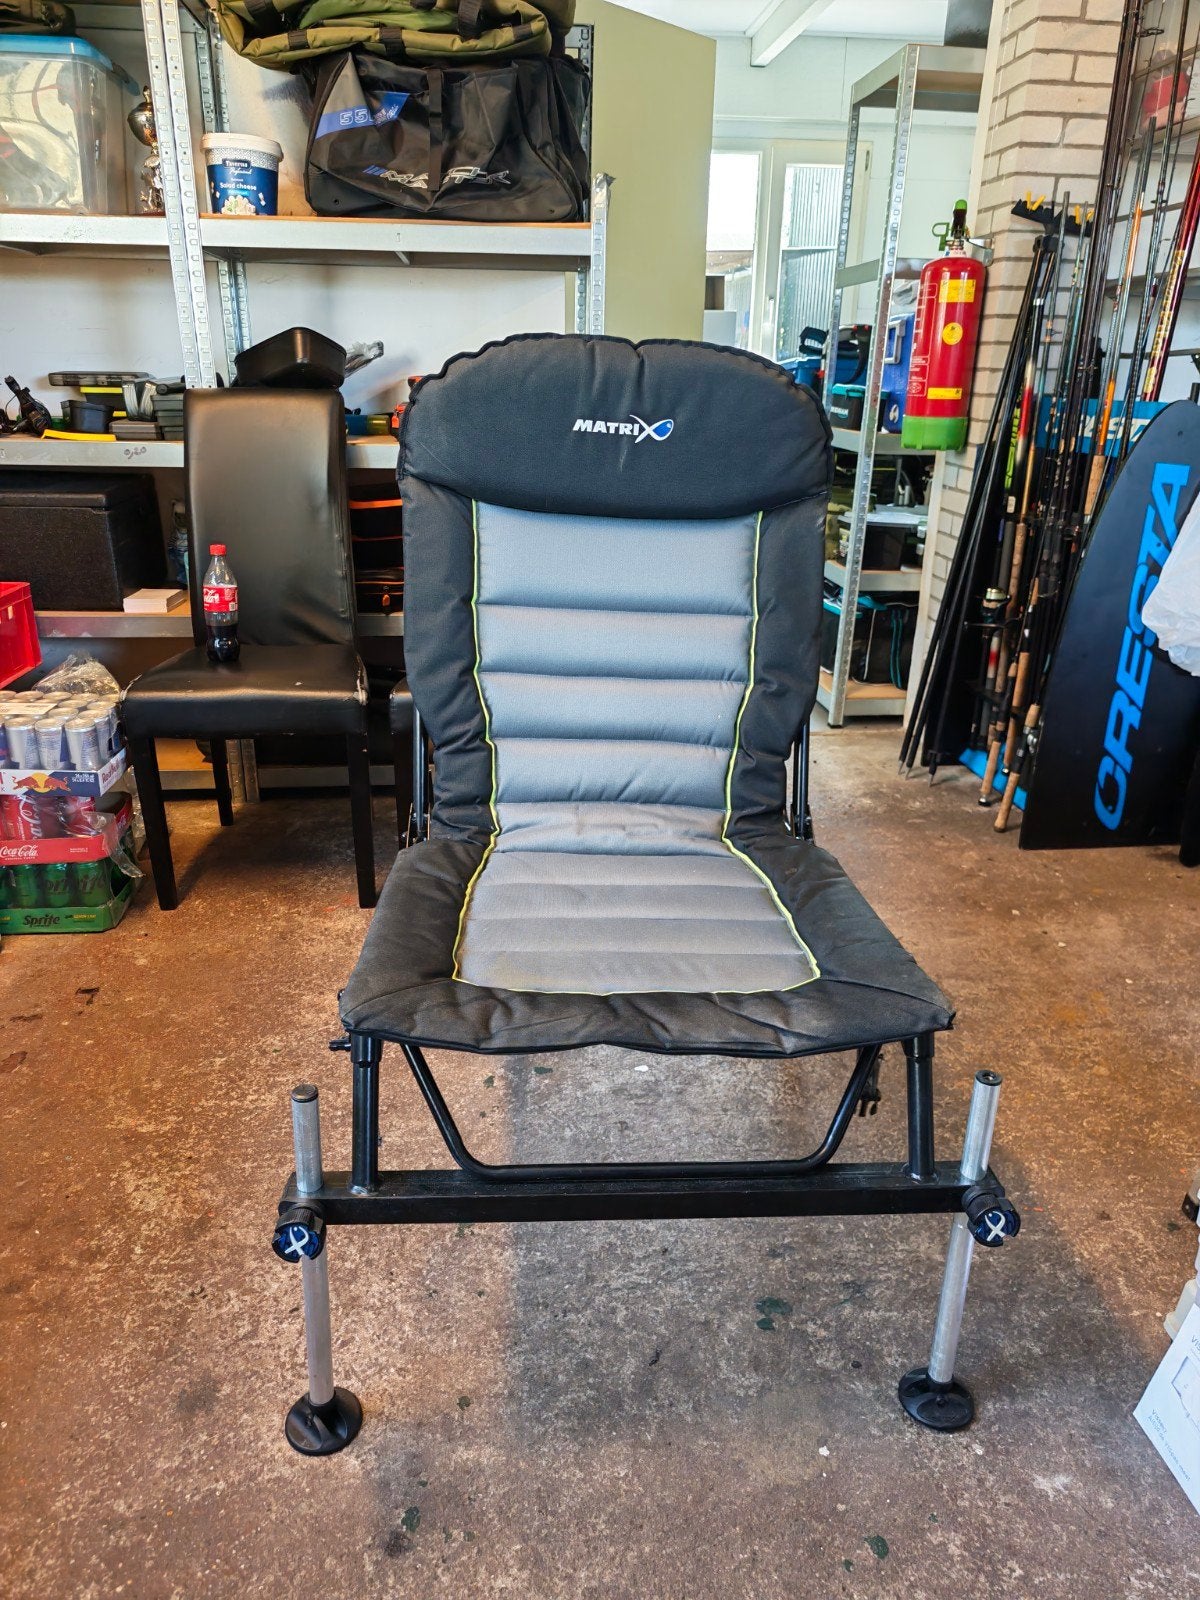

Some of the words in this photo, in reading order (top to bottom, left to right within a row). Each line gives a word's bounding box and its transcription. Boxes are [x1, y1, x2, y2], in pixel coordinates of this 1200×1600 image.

[219, 182, 236, 190] Salad
[236, 183, 257, 191] cheese
[572, 414, 674, 444] MATRIX
[23, 914, 61, 928] Sprite
